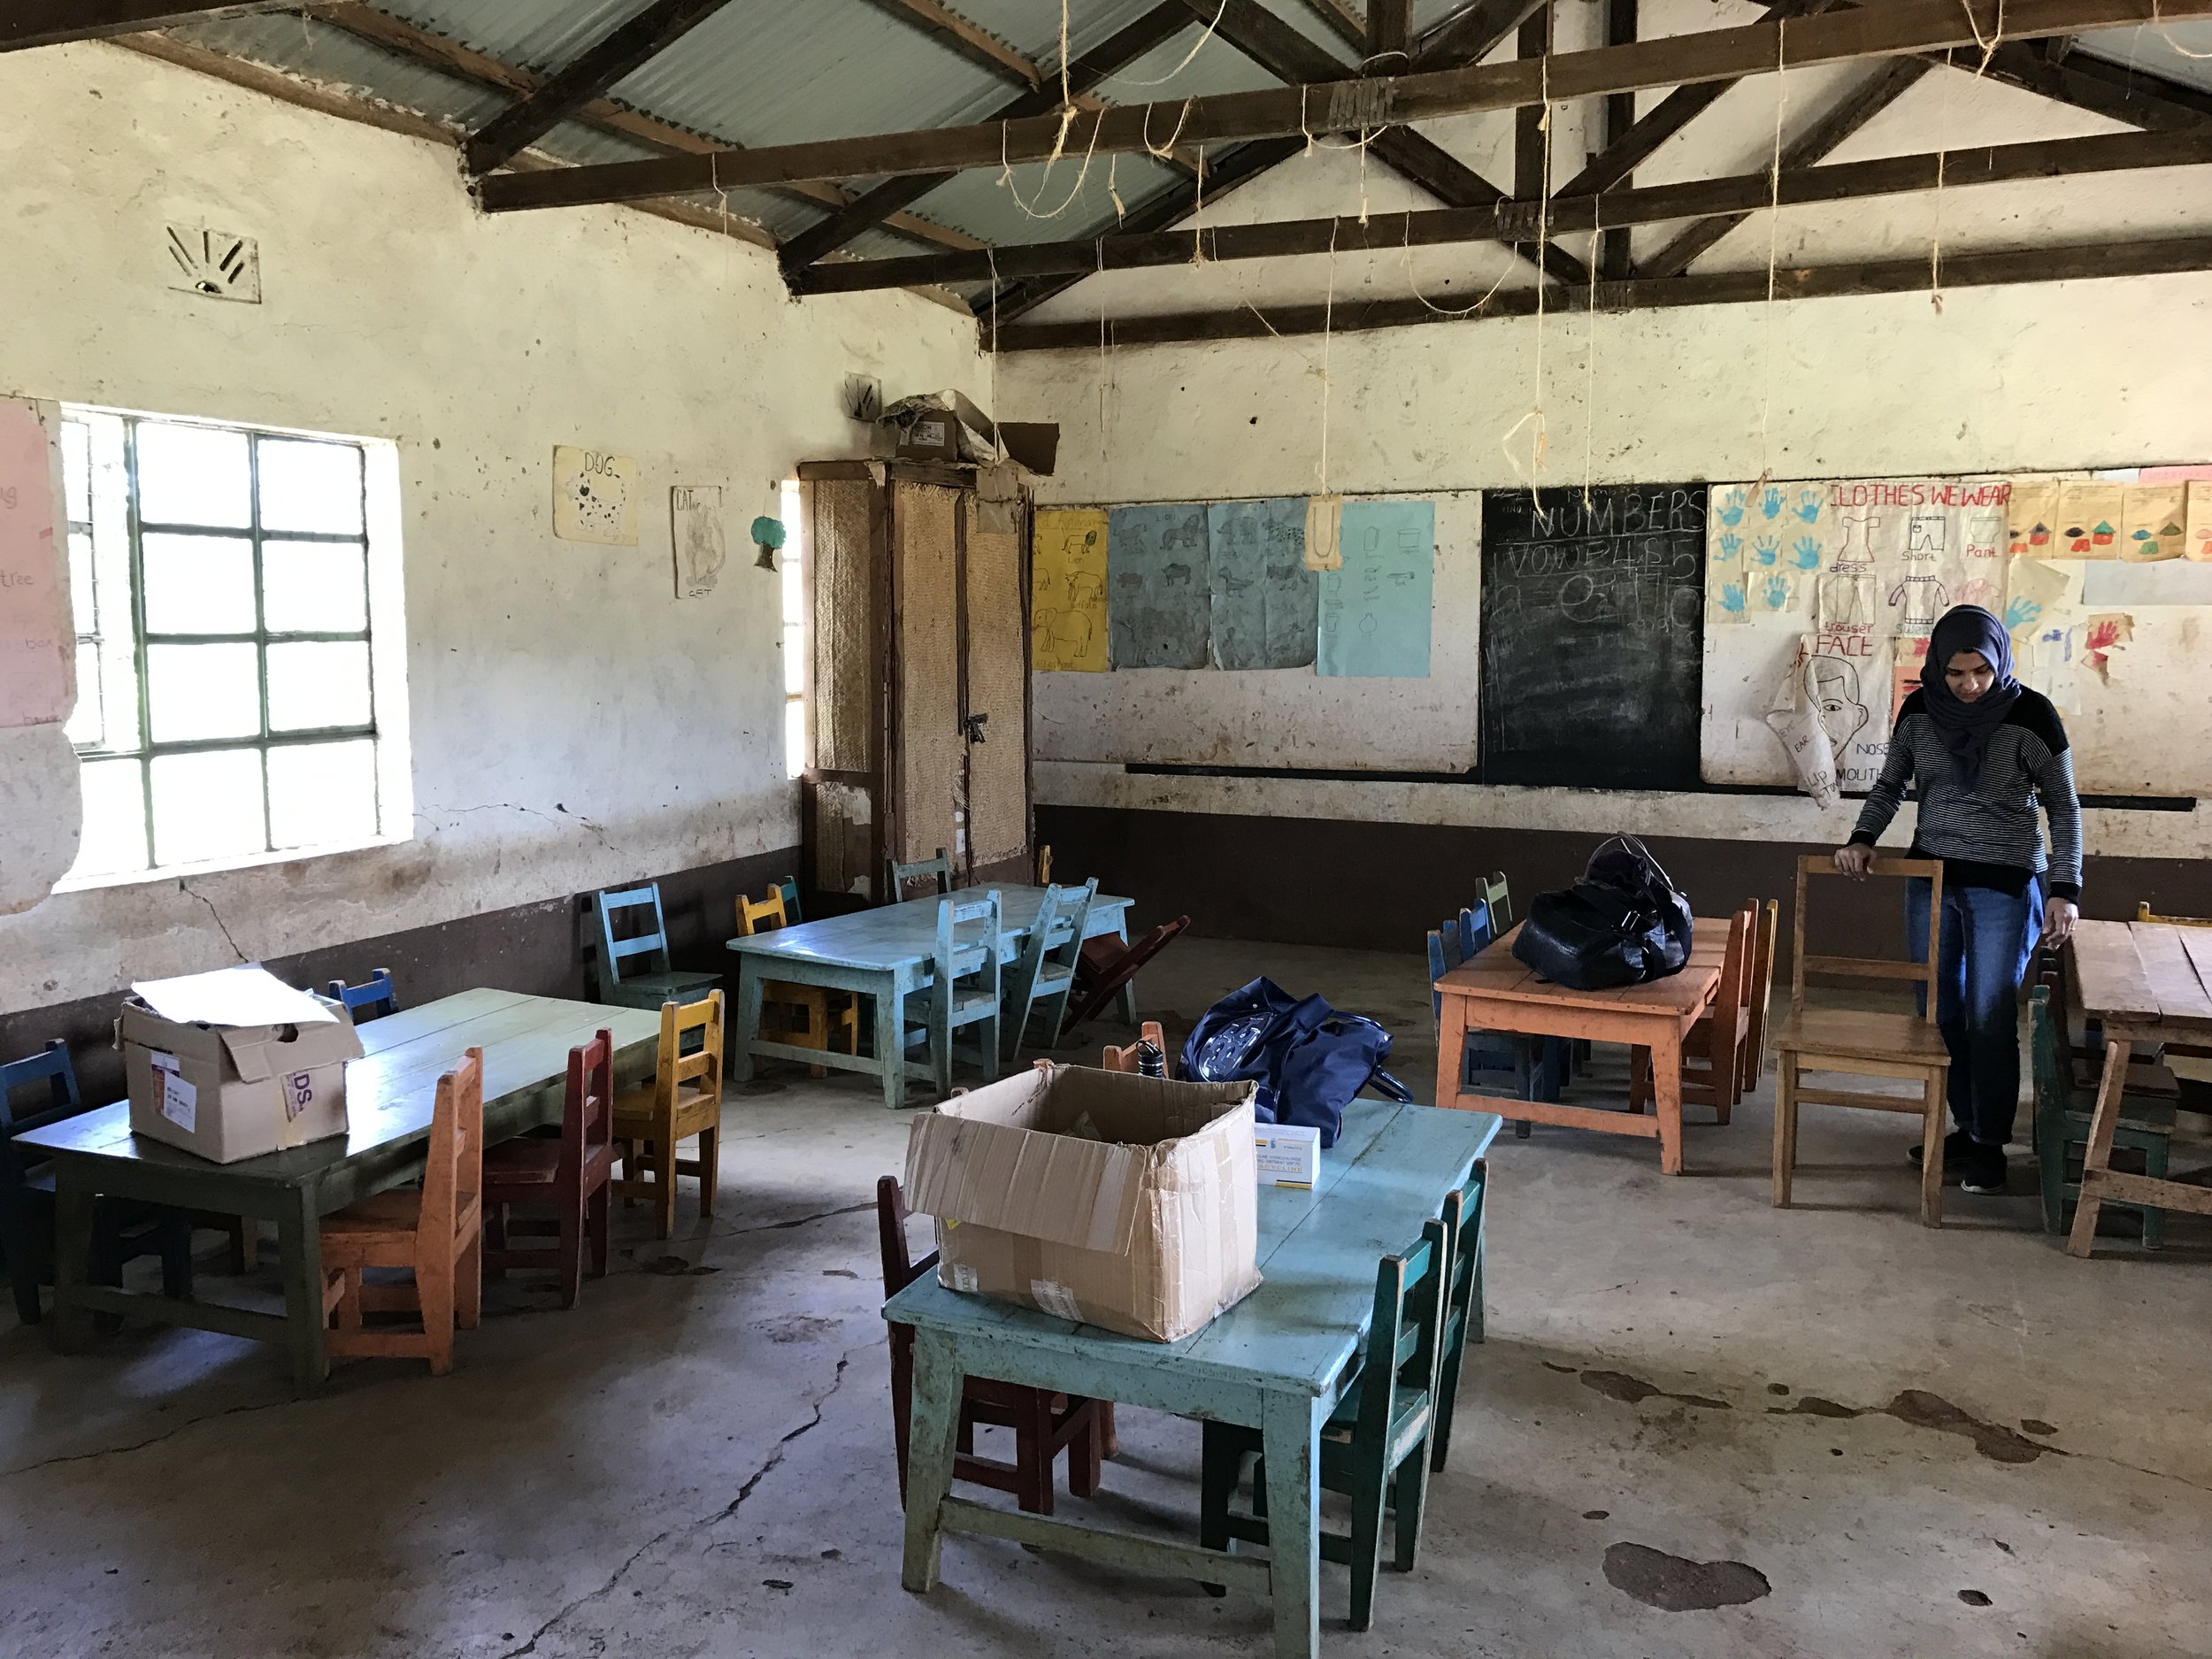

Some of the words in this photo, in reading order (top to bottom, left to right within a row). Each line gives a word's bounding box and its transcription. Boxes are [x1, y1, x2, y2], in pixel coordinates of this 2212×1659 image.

[585, 452, 615, 477] DOG
[677, 489, 694, 511] CAT
[1932, 484, 1958, 507] WE
[1961, 484, 2012, 507] WEAR
[1532, 490, 1706, 538] NUMBERS
[1966, 544, 1999, 558] Pant
[1830, 562, 1867, 573] dress
[0, 570, 34, 588] tree
[1824, 622, 1873, 634] trouser
[1816, 634, 1874, 657] FACE
[1794, 735, 1809, 753] EAR
